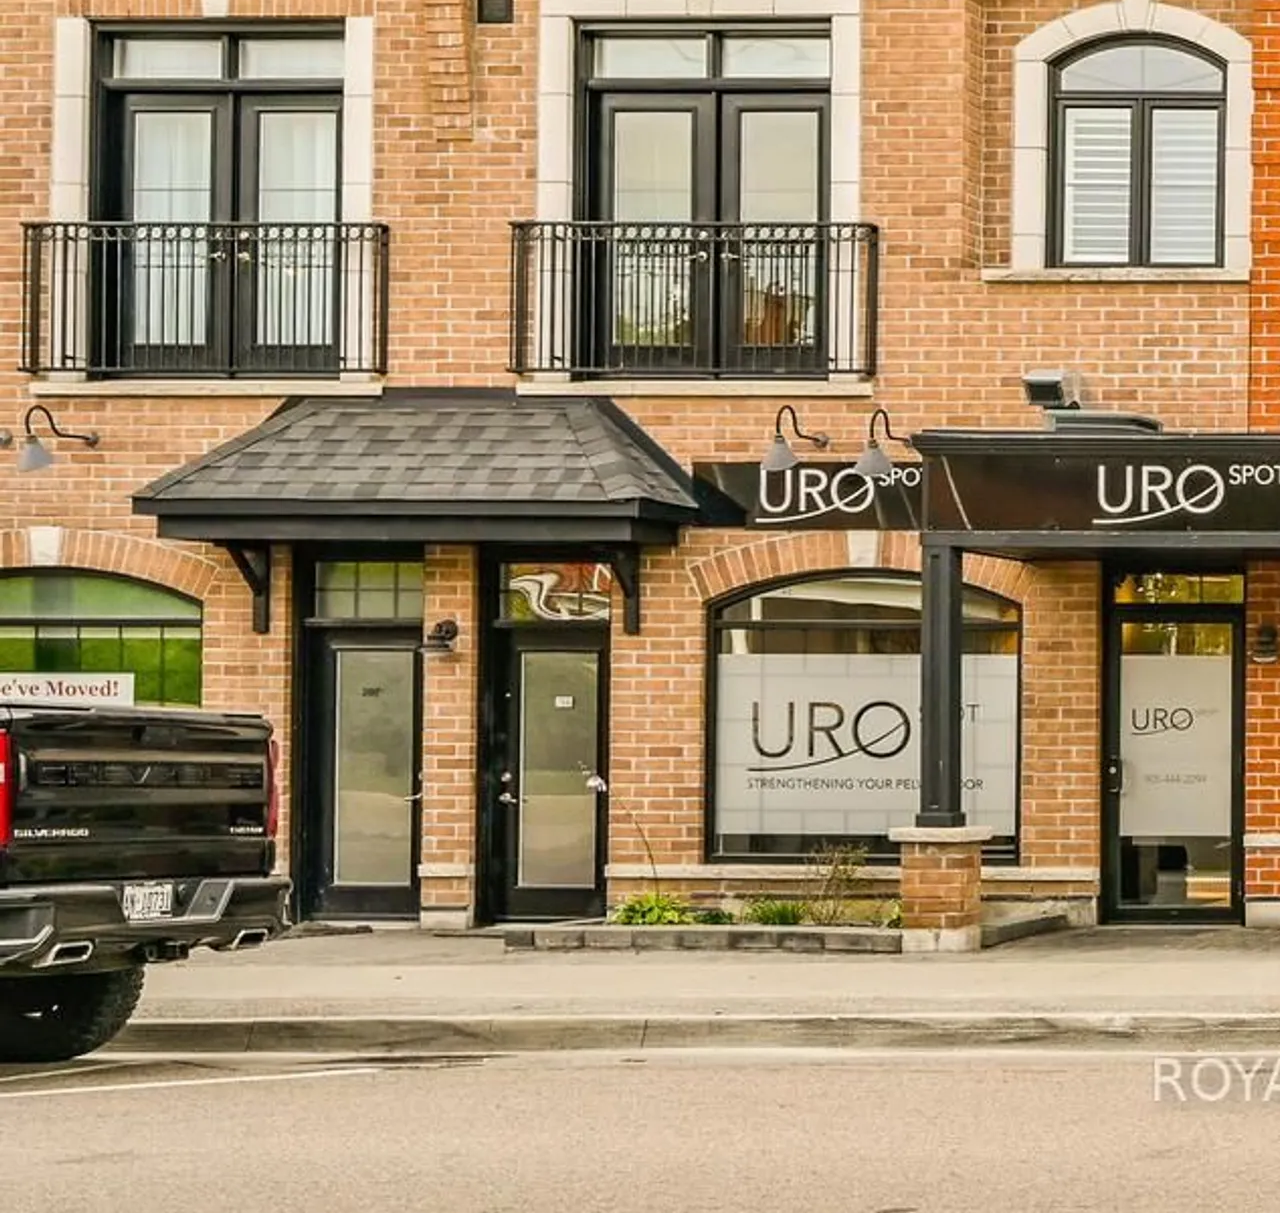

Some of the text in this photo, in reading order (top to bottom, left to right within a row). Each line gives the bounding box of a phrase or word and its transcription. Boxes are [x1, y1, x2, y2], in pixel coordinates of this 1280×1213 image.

[759, 467, 923, 513] URO SPO
[1097, 464, 1225, 514] URO
[0, 679, 119, 697] e've Moved!
[752, 701, 911, 758] URO
[1132, 708, 1193, 731] URO
[747, 778, 921, 789] STRENGTHENING YOUR PEL
